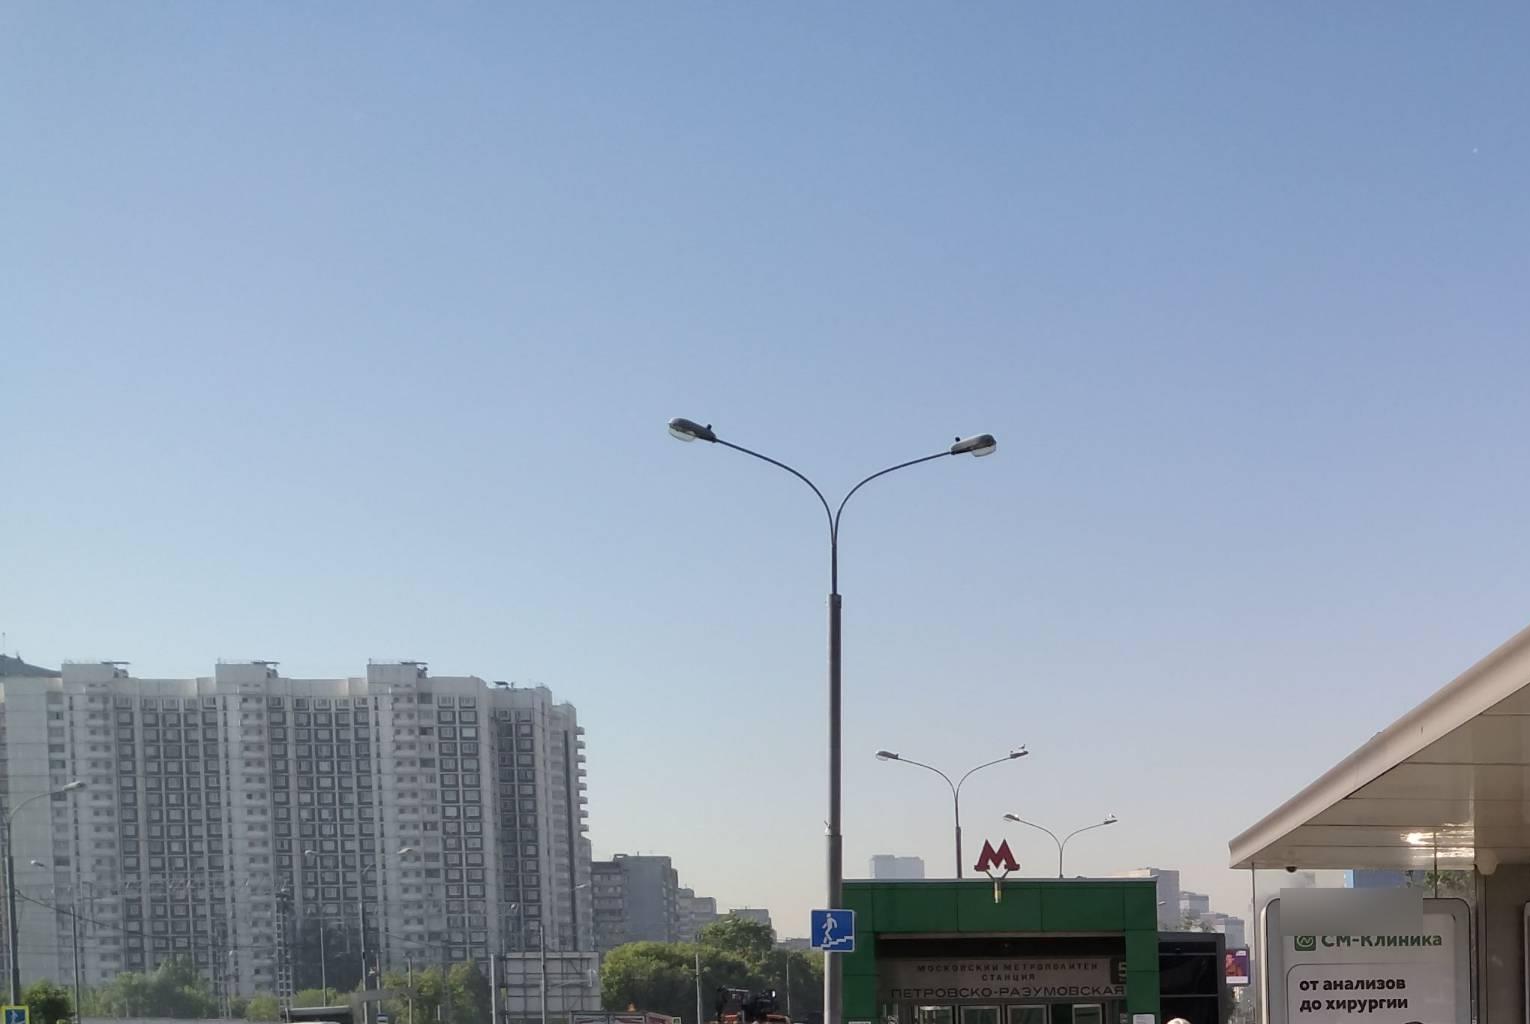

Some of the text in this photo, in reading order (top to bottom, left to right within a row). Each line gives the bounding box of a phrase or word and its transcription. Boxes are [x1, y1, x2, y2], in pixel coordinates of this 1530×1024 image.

[980, 973, 1035, 982] СТАНЦИЯ
[1299, 978, 1406, 992] от анализов
[890, 986, 1125, 999] ПЕТРОВСКО-РАЗУМОВСКАЯ
[1299, 998, 1408, 1014] до хирургии
